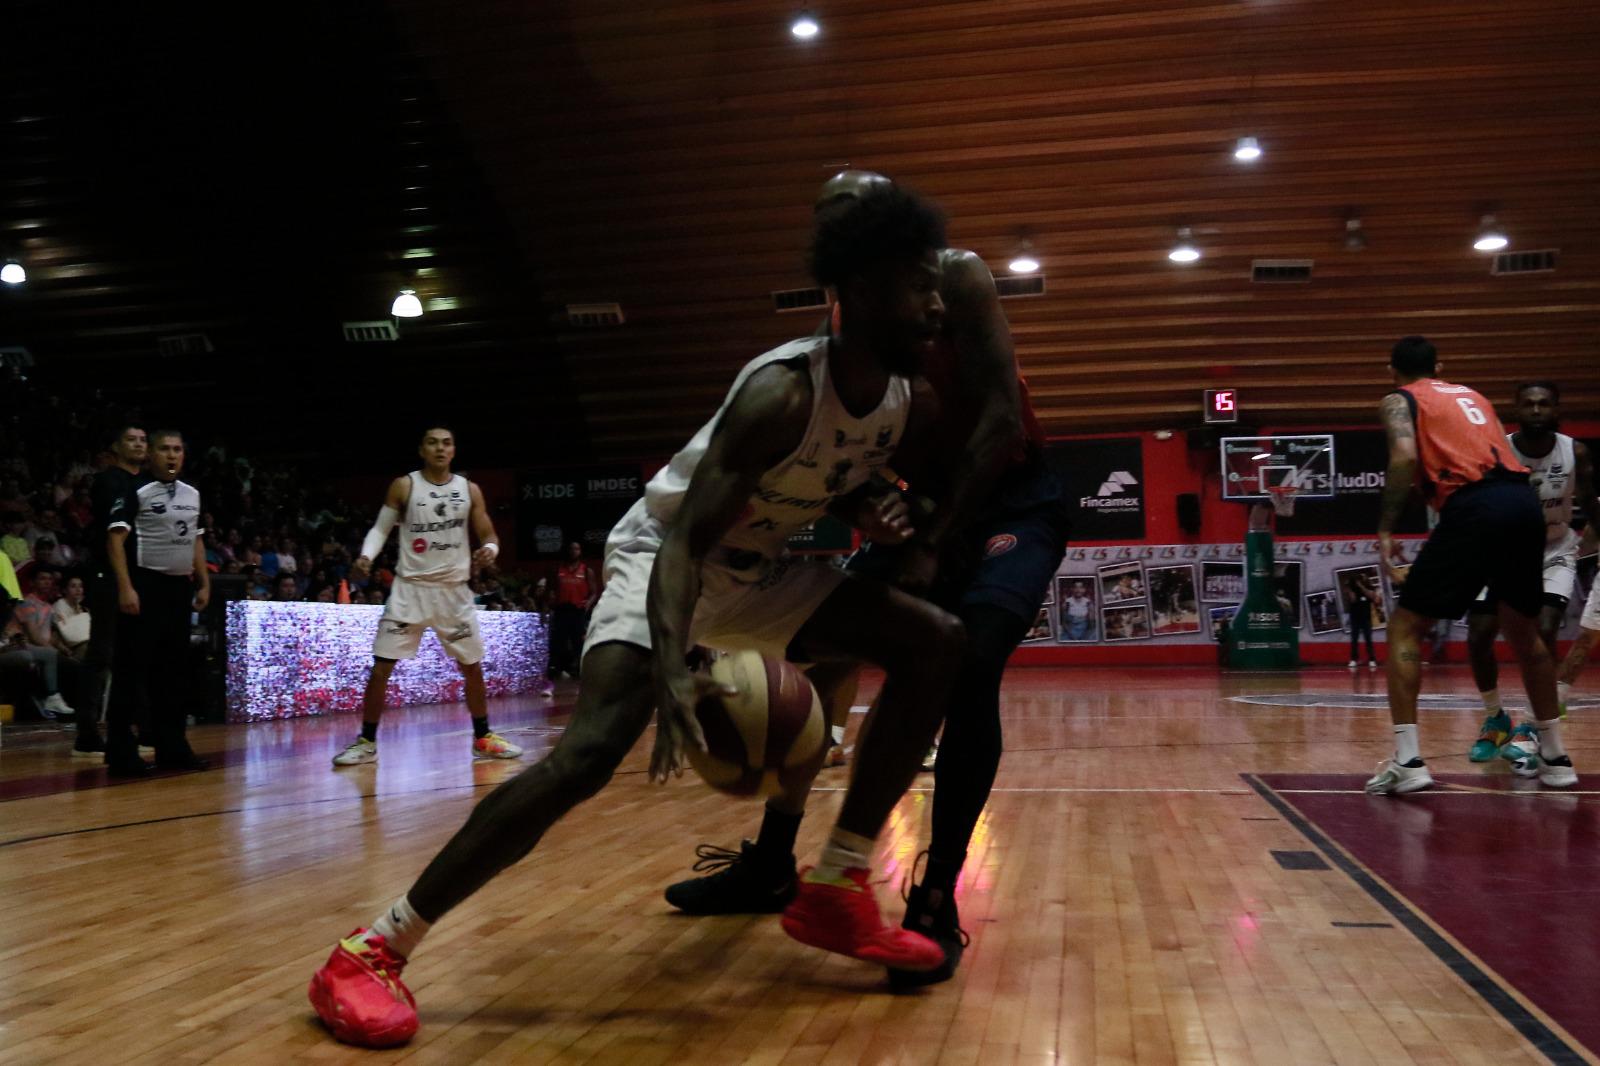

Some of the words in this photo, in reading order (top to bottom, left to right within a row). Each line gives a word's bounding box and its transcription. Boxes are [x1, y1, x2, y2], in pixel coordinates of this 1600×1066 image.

[1216, 393, 1233, 410] 15
[1456, 397, 1487, 425] 6
[538, 483, 575, 499] ISDE
[588, 477, 638, 492] IMDEC
[1080, 496, 1139, 508] Fincamex
